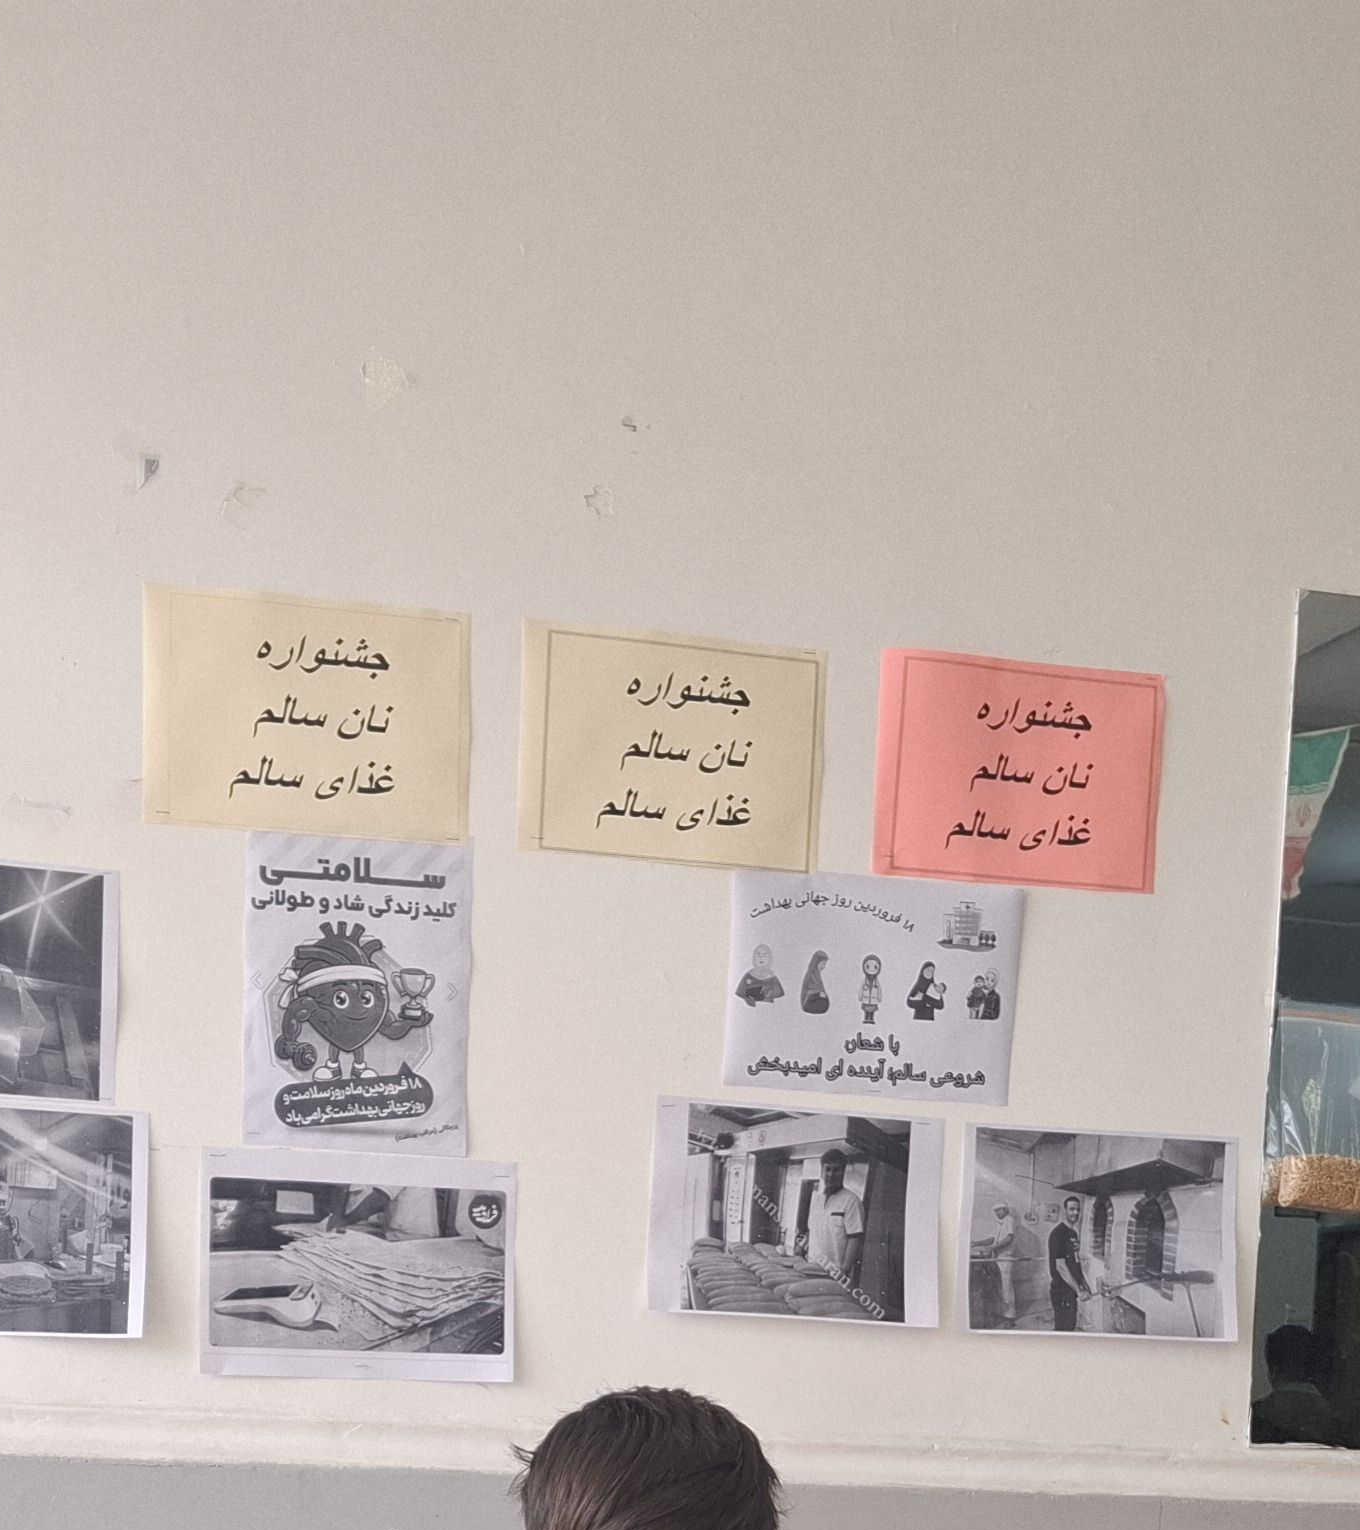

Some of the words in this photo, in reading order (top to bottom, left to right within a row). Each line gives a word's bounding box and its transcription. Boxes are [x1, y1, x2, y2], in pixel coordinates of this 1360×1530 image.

[256, 634, 391, 680] جشنواره
[626, 671, 751, 716] جشنواره
[251, 693, 328, 739] سالم
[336, 703, 394, 740] نان
[976, 697, 1093, 740] جشنواره
[619, 728, 691, 772] سالم
[698, 738, 753, 774] نان
[228, 754, 304, 800] سالم
[314, 760, 396, 801] غذای
[969, 752, 1035, 793] سالم
[1041, 761, 1095, 796] نان
[595, 787, 667, 830] سالم
[675, 793, 752, 832] غذای
[944, 808, 1011, 850] سالم
[1018, 814, 1091, 851] غذای
[258, 856, 447, 890] سلامتی
[250, 888, 316, 913] طولانی
[318, 896, 331, 915] و
[333, 893, 365, 912] شاد
[367, 894, 420, 921] زندگی
[422, 900, 458, 922] کلید
[749, 896, 793, 919] بهداشت
[794, 889, 830, 909] جهانی
[830, 892, 853, 909] روز
[853, 899, 903, 924] فروردین
[888, 1033, 900, 1057] با
[362, 1075, 409, 1098] فروردین
[929, 1070, 986, 1089] شروعی
